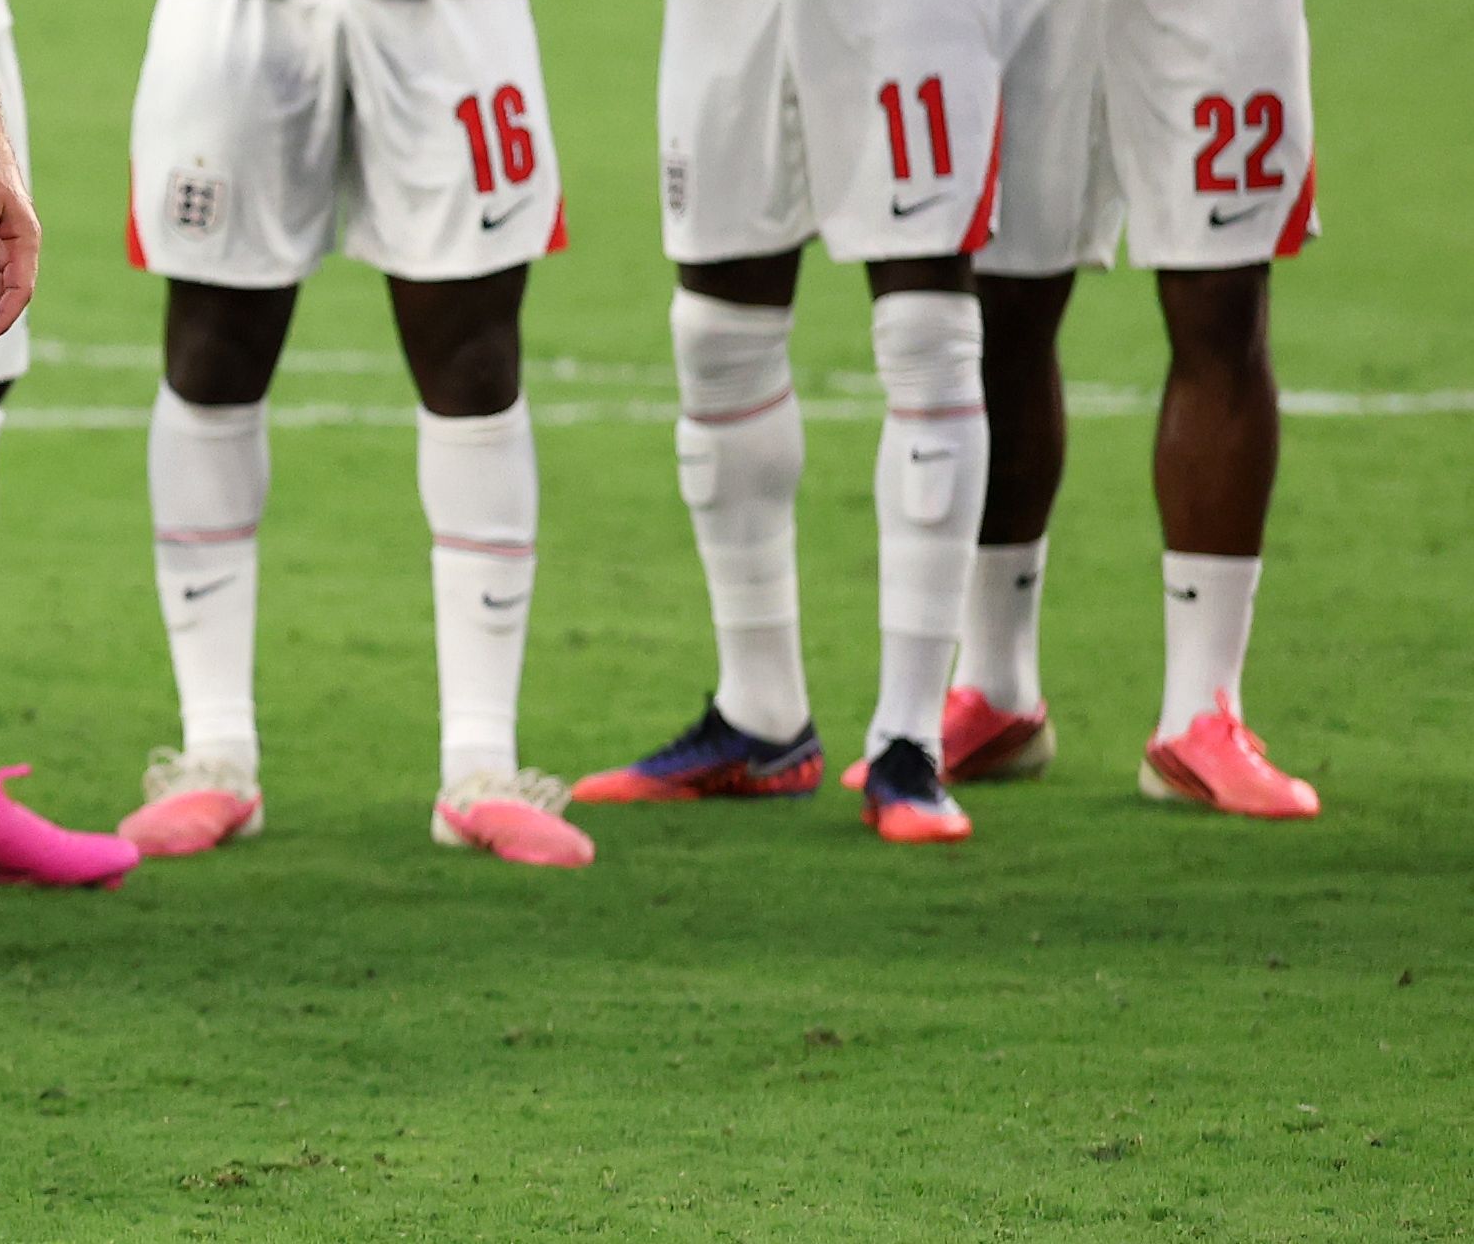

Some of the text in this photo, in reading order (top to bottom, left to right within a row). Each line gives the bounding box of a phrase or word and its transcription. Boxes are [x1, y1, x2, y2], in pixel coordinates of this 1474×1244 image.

[455, 83, 535, 194] 16
[878, 72, 952, 181] 11
[1193, 91, 1284, 194] 22
